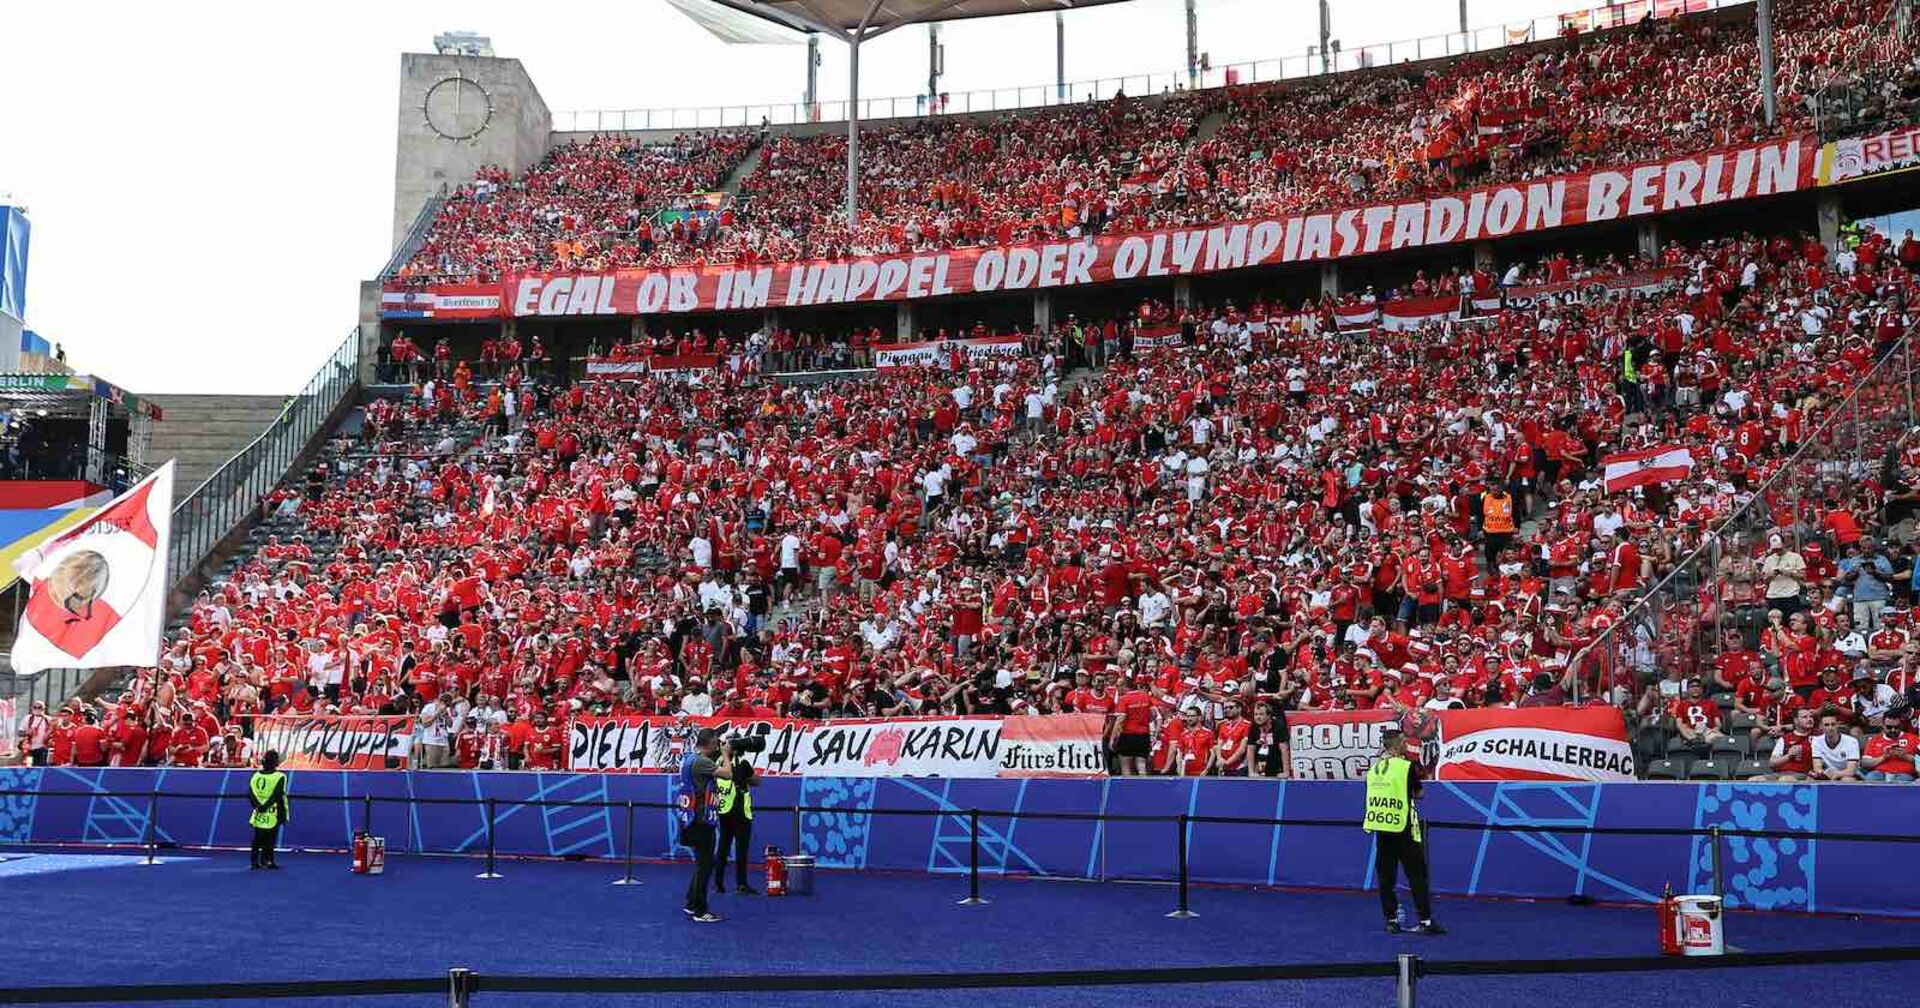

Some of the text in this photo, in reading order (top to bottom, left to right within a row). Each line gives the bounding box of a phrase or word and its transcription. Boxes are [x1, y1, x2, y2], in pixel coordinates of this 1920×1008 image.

[514, 140, 1800, 316] EGAL OB IM HAPPEL ODER OLYMPIASTADION BERLIN
[572, 720, 649, 771] PIELA
[807, 727, 871, 767] SAU
[1367, 810, 1400, 825] 0605
